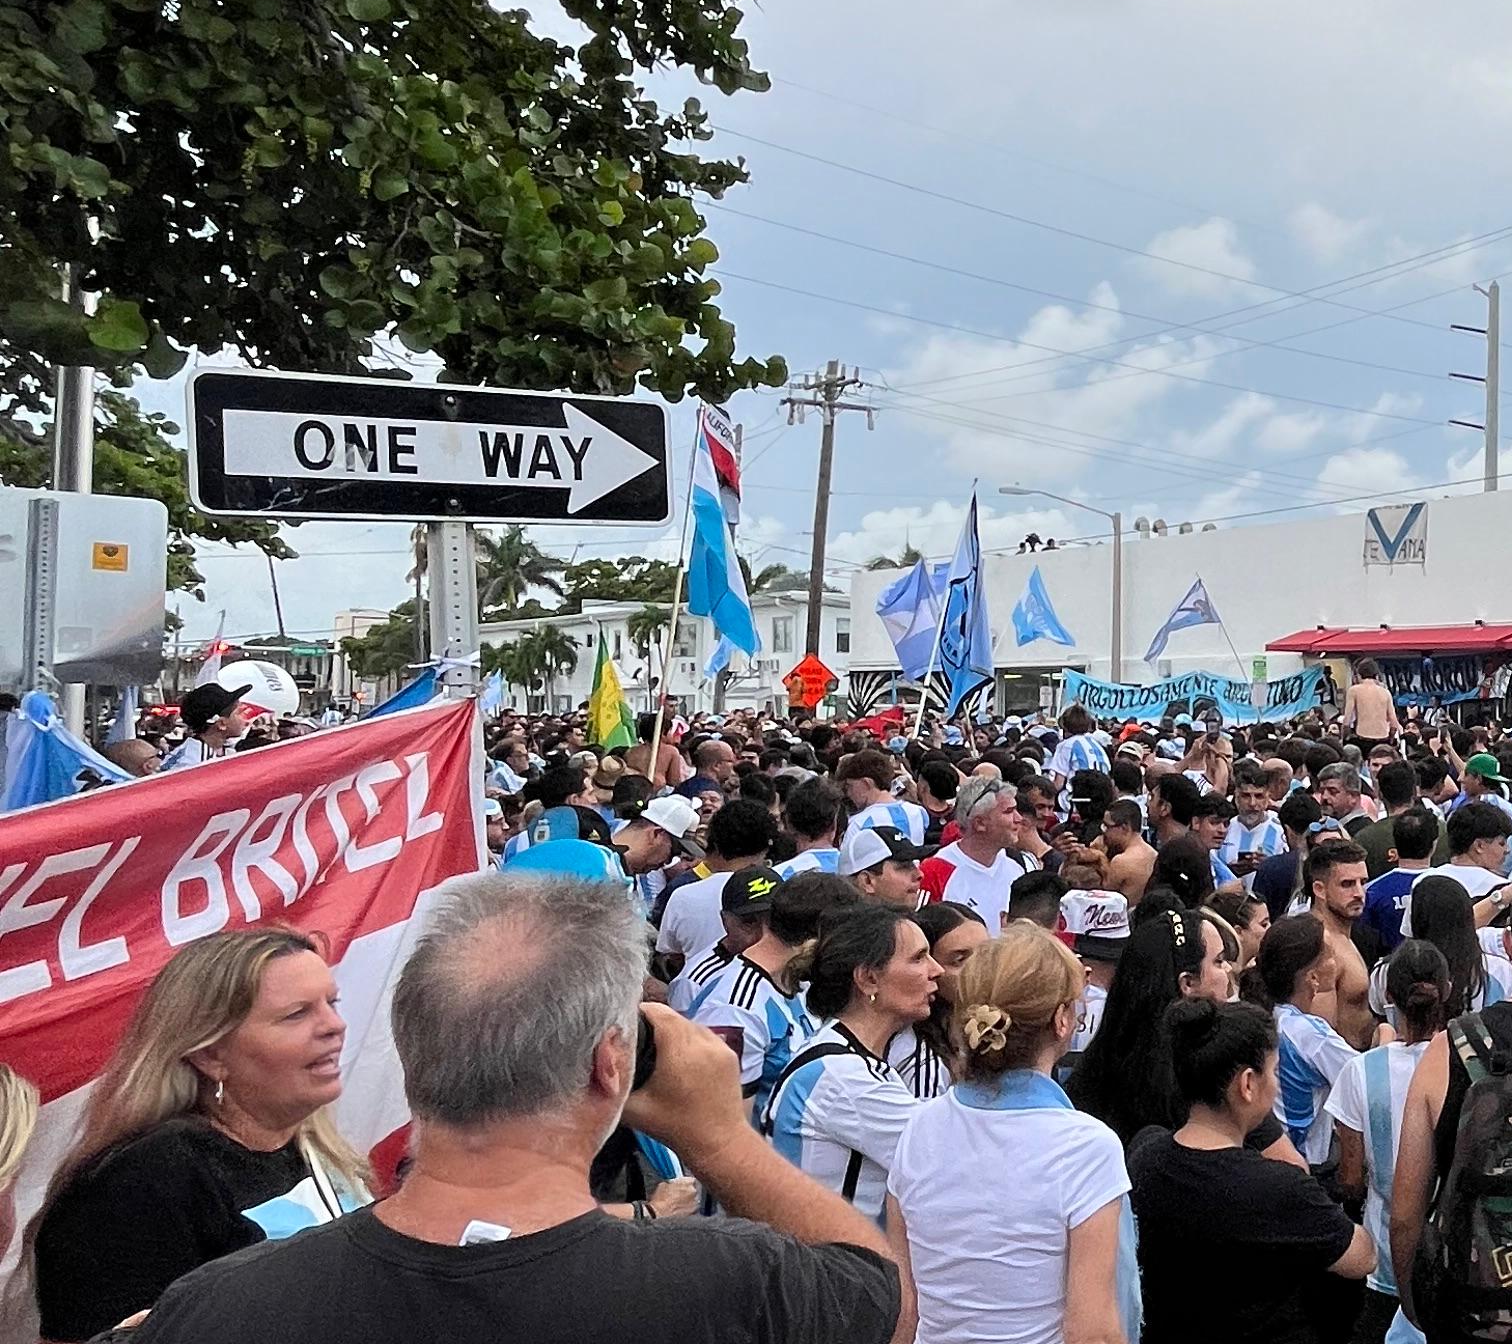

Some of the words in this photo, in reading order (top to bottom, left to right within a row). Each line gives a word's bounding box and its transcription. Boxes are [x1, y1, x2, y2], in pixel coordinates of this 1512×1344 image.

[294, 420, 418, 474] ONE
[479, 431, 592, 481] WAY
[1222, 674, 1304, 708] ARGTINO
